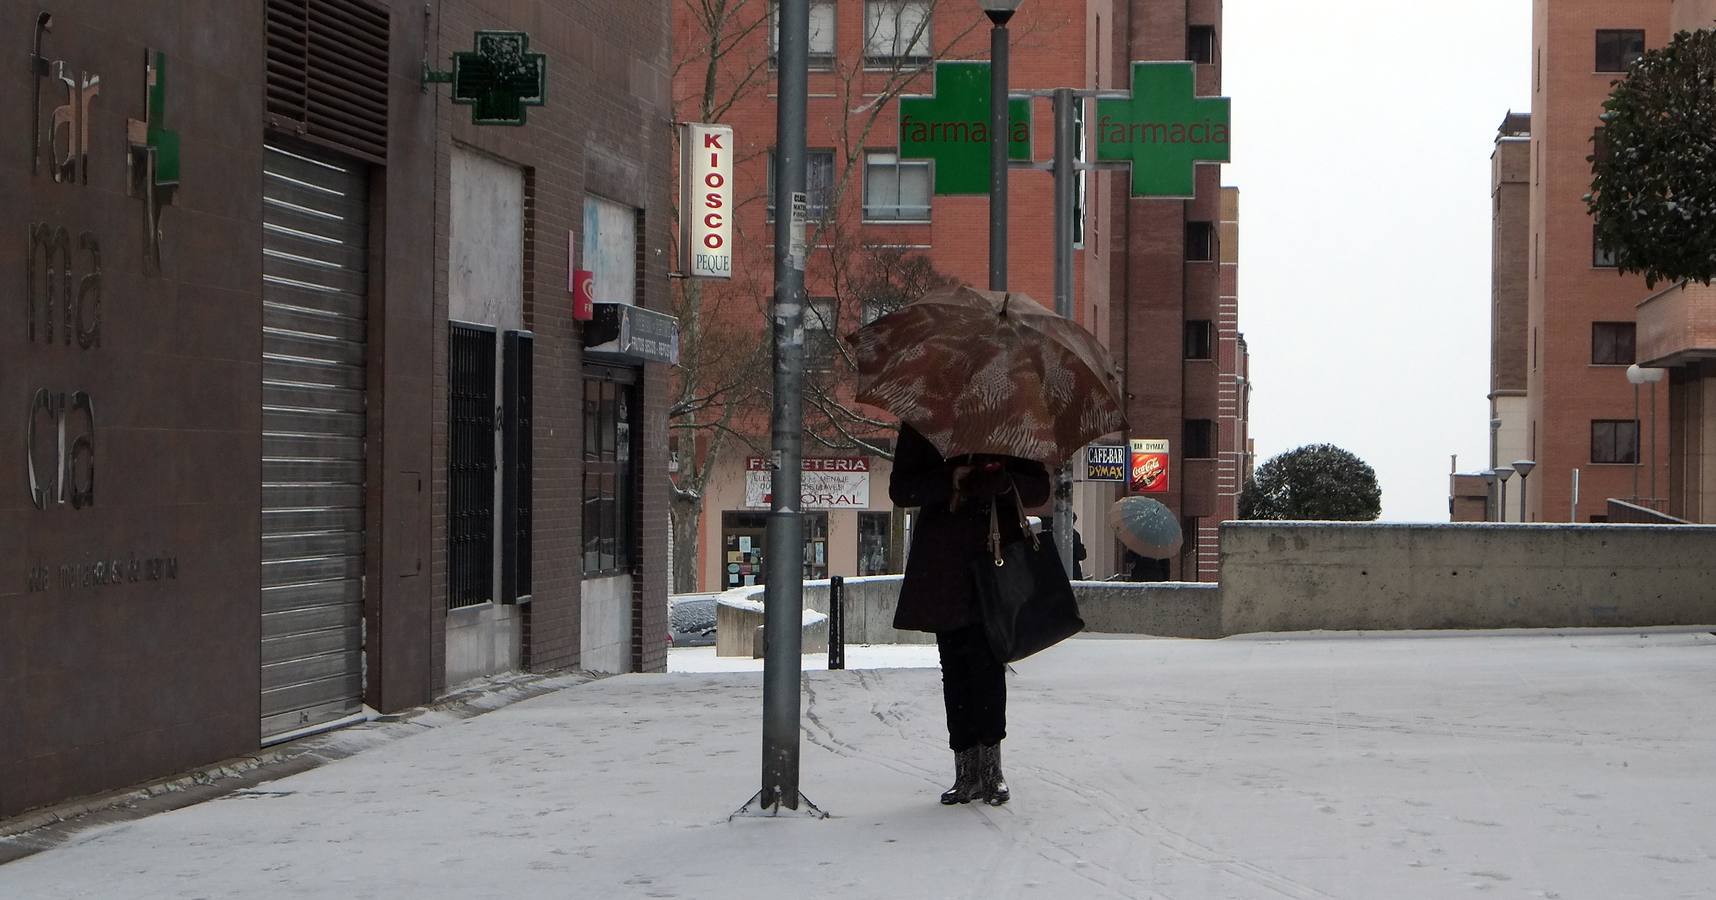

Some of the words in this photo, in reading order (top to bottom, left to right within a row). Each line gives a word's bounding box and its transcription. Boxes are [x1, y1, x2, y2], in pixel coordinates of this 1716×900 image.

[30, 11, 100, 186] far
[899, 115, 1029, 144] farmaia
[1098, 115, 1230, 144] farmacia
[704, 132, 725, 250] KIOSCO
[696, 252, 730, 274] PEQUE
[749, 458, 867, 471] FEETERIA
[1088, 448, 1124, 464] CAFE-BAR
[1088, 465, 1123, 479] DYMAX
